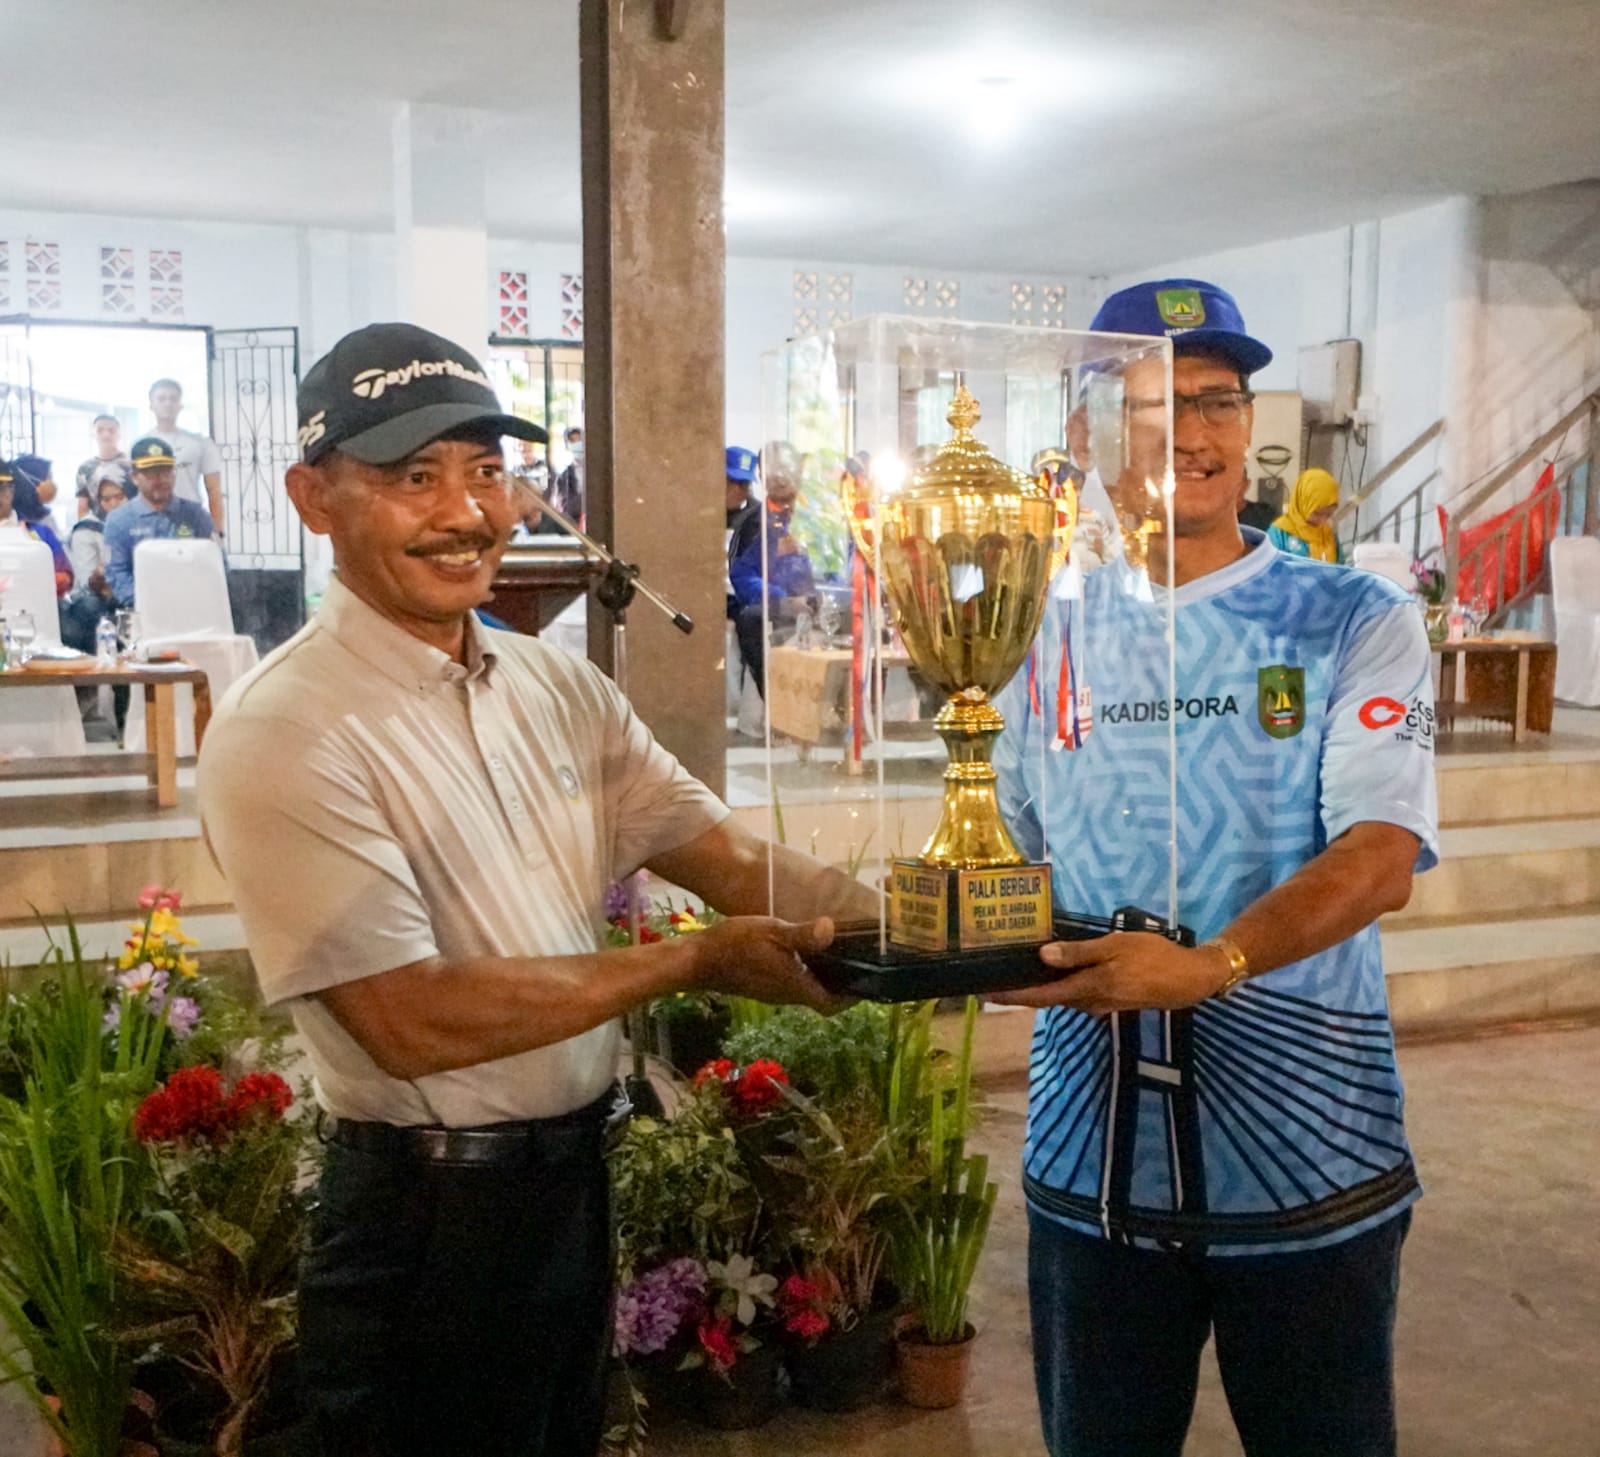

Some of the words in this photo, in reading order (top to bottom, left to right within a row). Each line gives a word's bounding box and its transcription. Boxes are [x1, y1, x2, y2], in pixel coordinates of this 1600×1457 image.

[1101, 694, 1239, 724] KADISPORA
[968, 879, 997, 900] PIALA
[1000, 876, 1041, 898] BERGILIR
[974, 905, 997, 918] PEKAN
